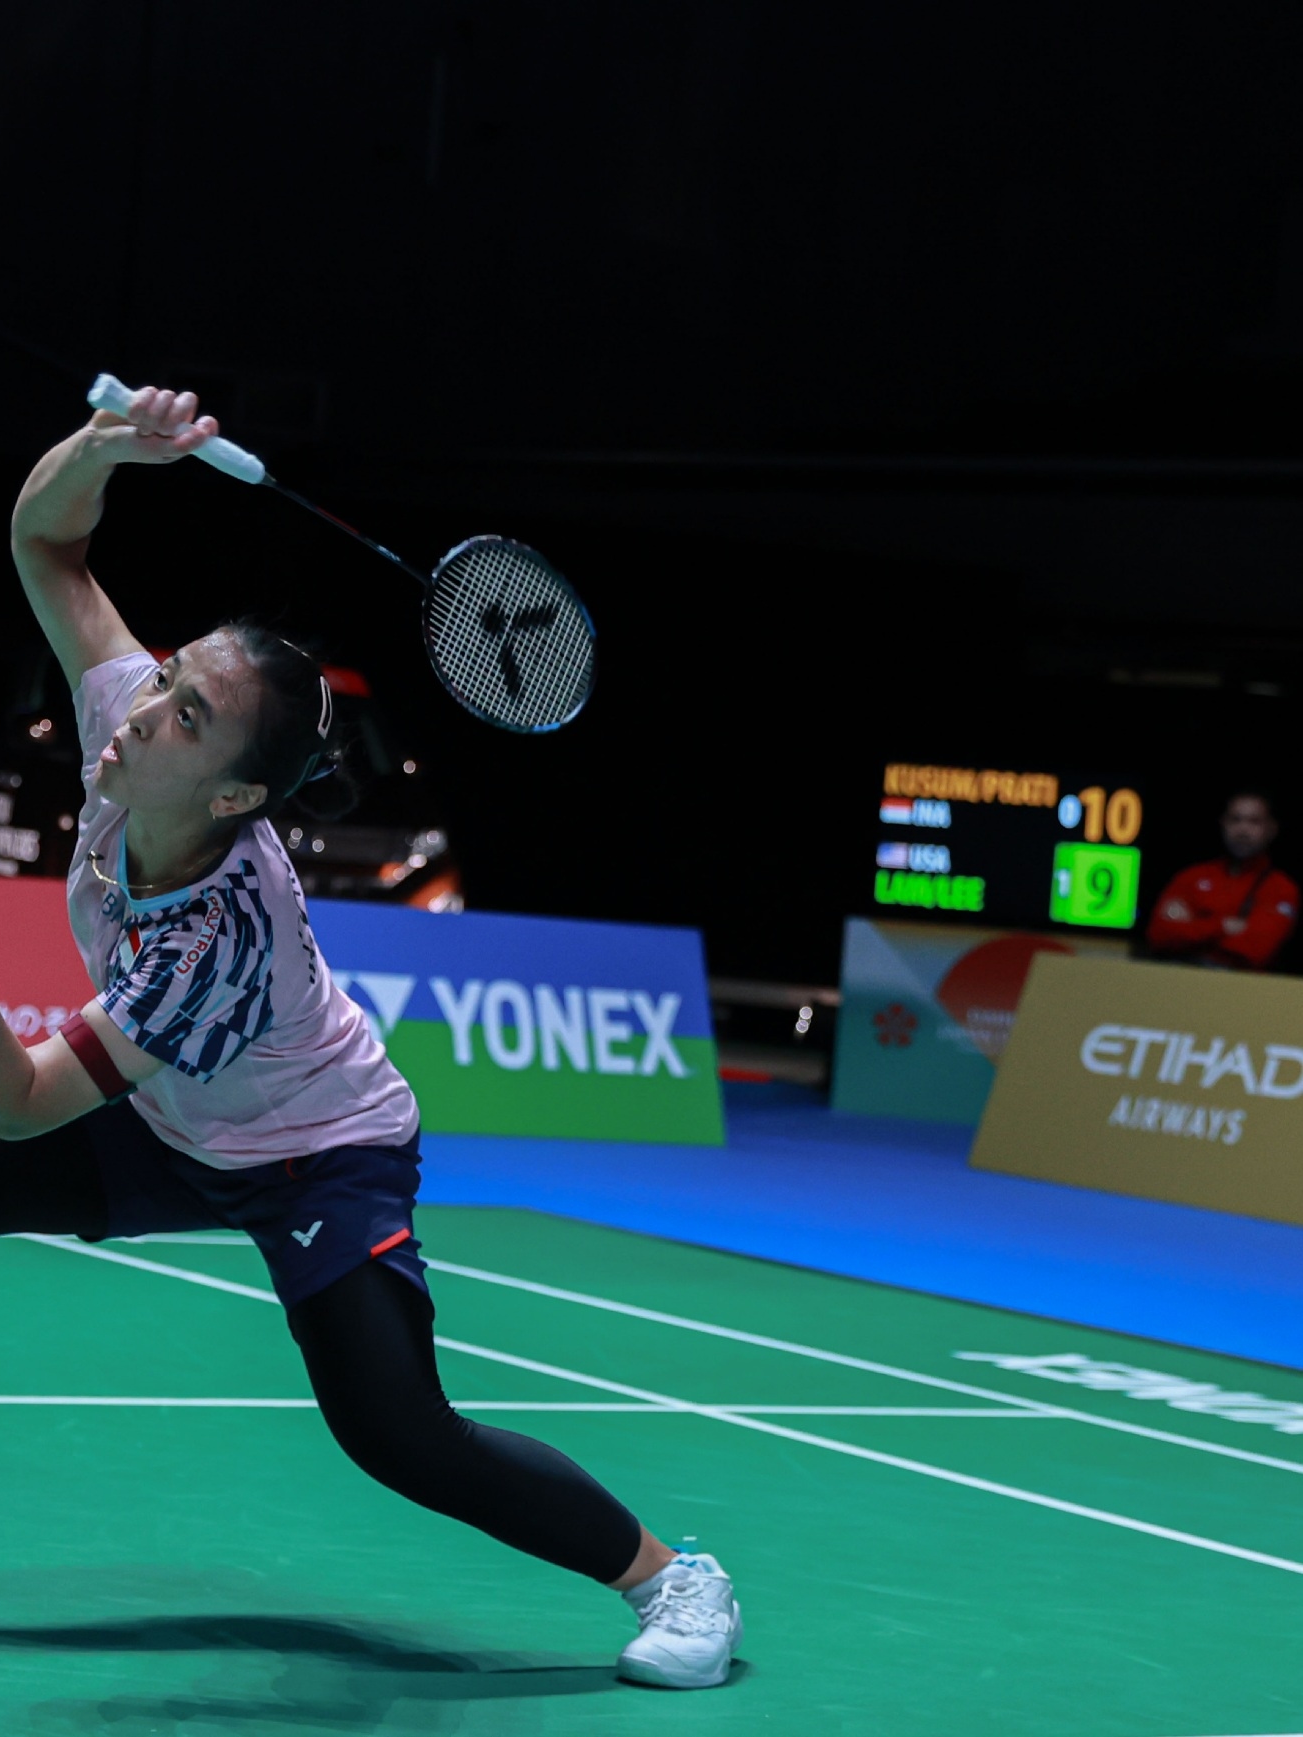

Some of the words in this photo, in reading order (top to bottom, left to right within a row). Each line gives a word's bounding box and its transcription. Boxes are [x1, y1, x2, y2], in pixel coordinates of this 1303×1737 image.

[1058, 794, 1083, 829] 0
[1079, 786, 1143, 845] 10
[909, 843, 951, 873] USA
[1088, 864, 1115, 914] 9
[429, 976, 687, 1078] YONEX
[1080, 1023, 1303, 1099] ETIHAD
[1108, 1095, 1247, 1146] AIRWAYS
